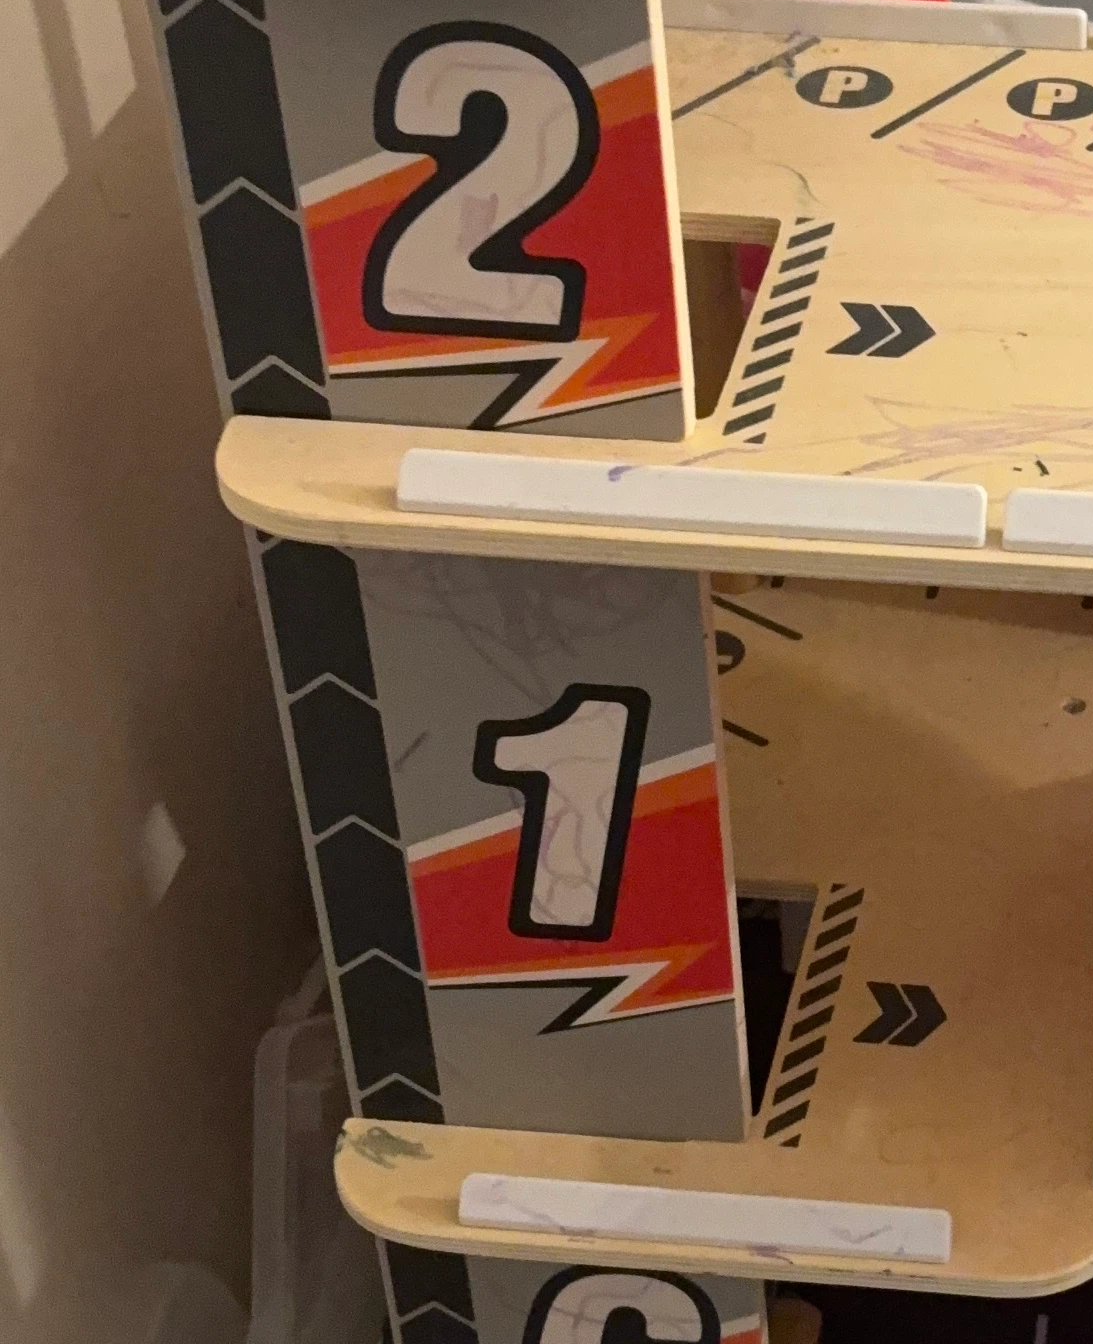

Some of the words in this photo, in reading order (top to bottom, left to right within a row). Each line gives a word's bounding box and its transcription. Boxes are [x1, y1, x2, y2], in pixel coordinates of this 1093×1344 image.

[818, 69, 868, 103] P
[1032, 82, 1077, 115] P
[368, 27, 592, 336] 2
[481, 689, 642, 936] 1
